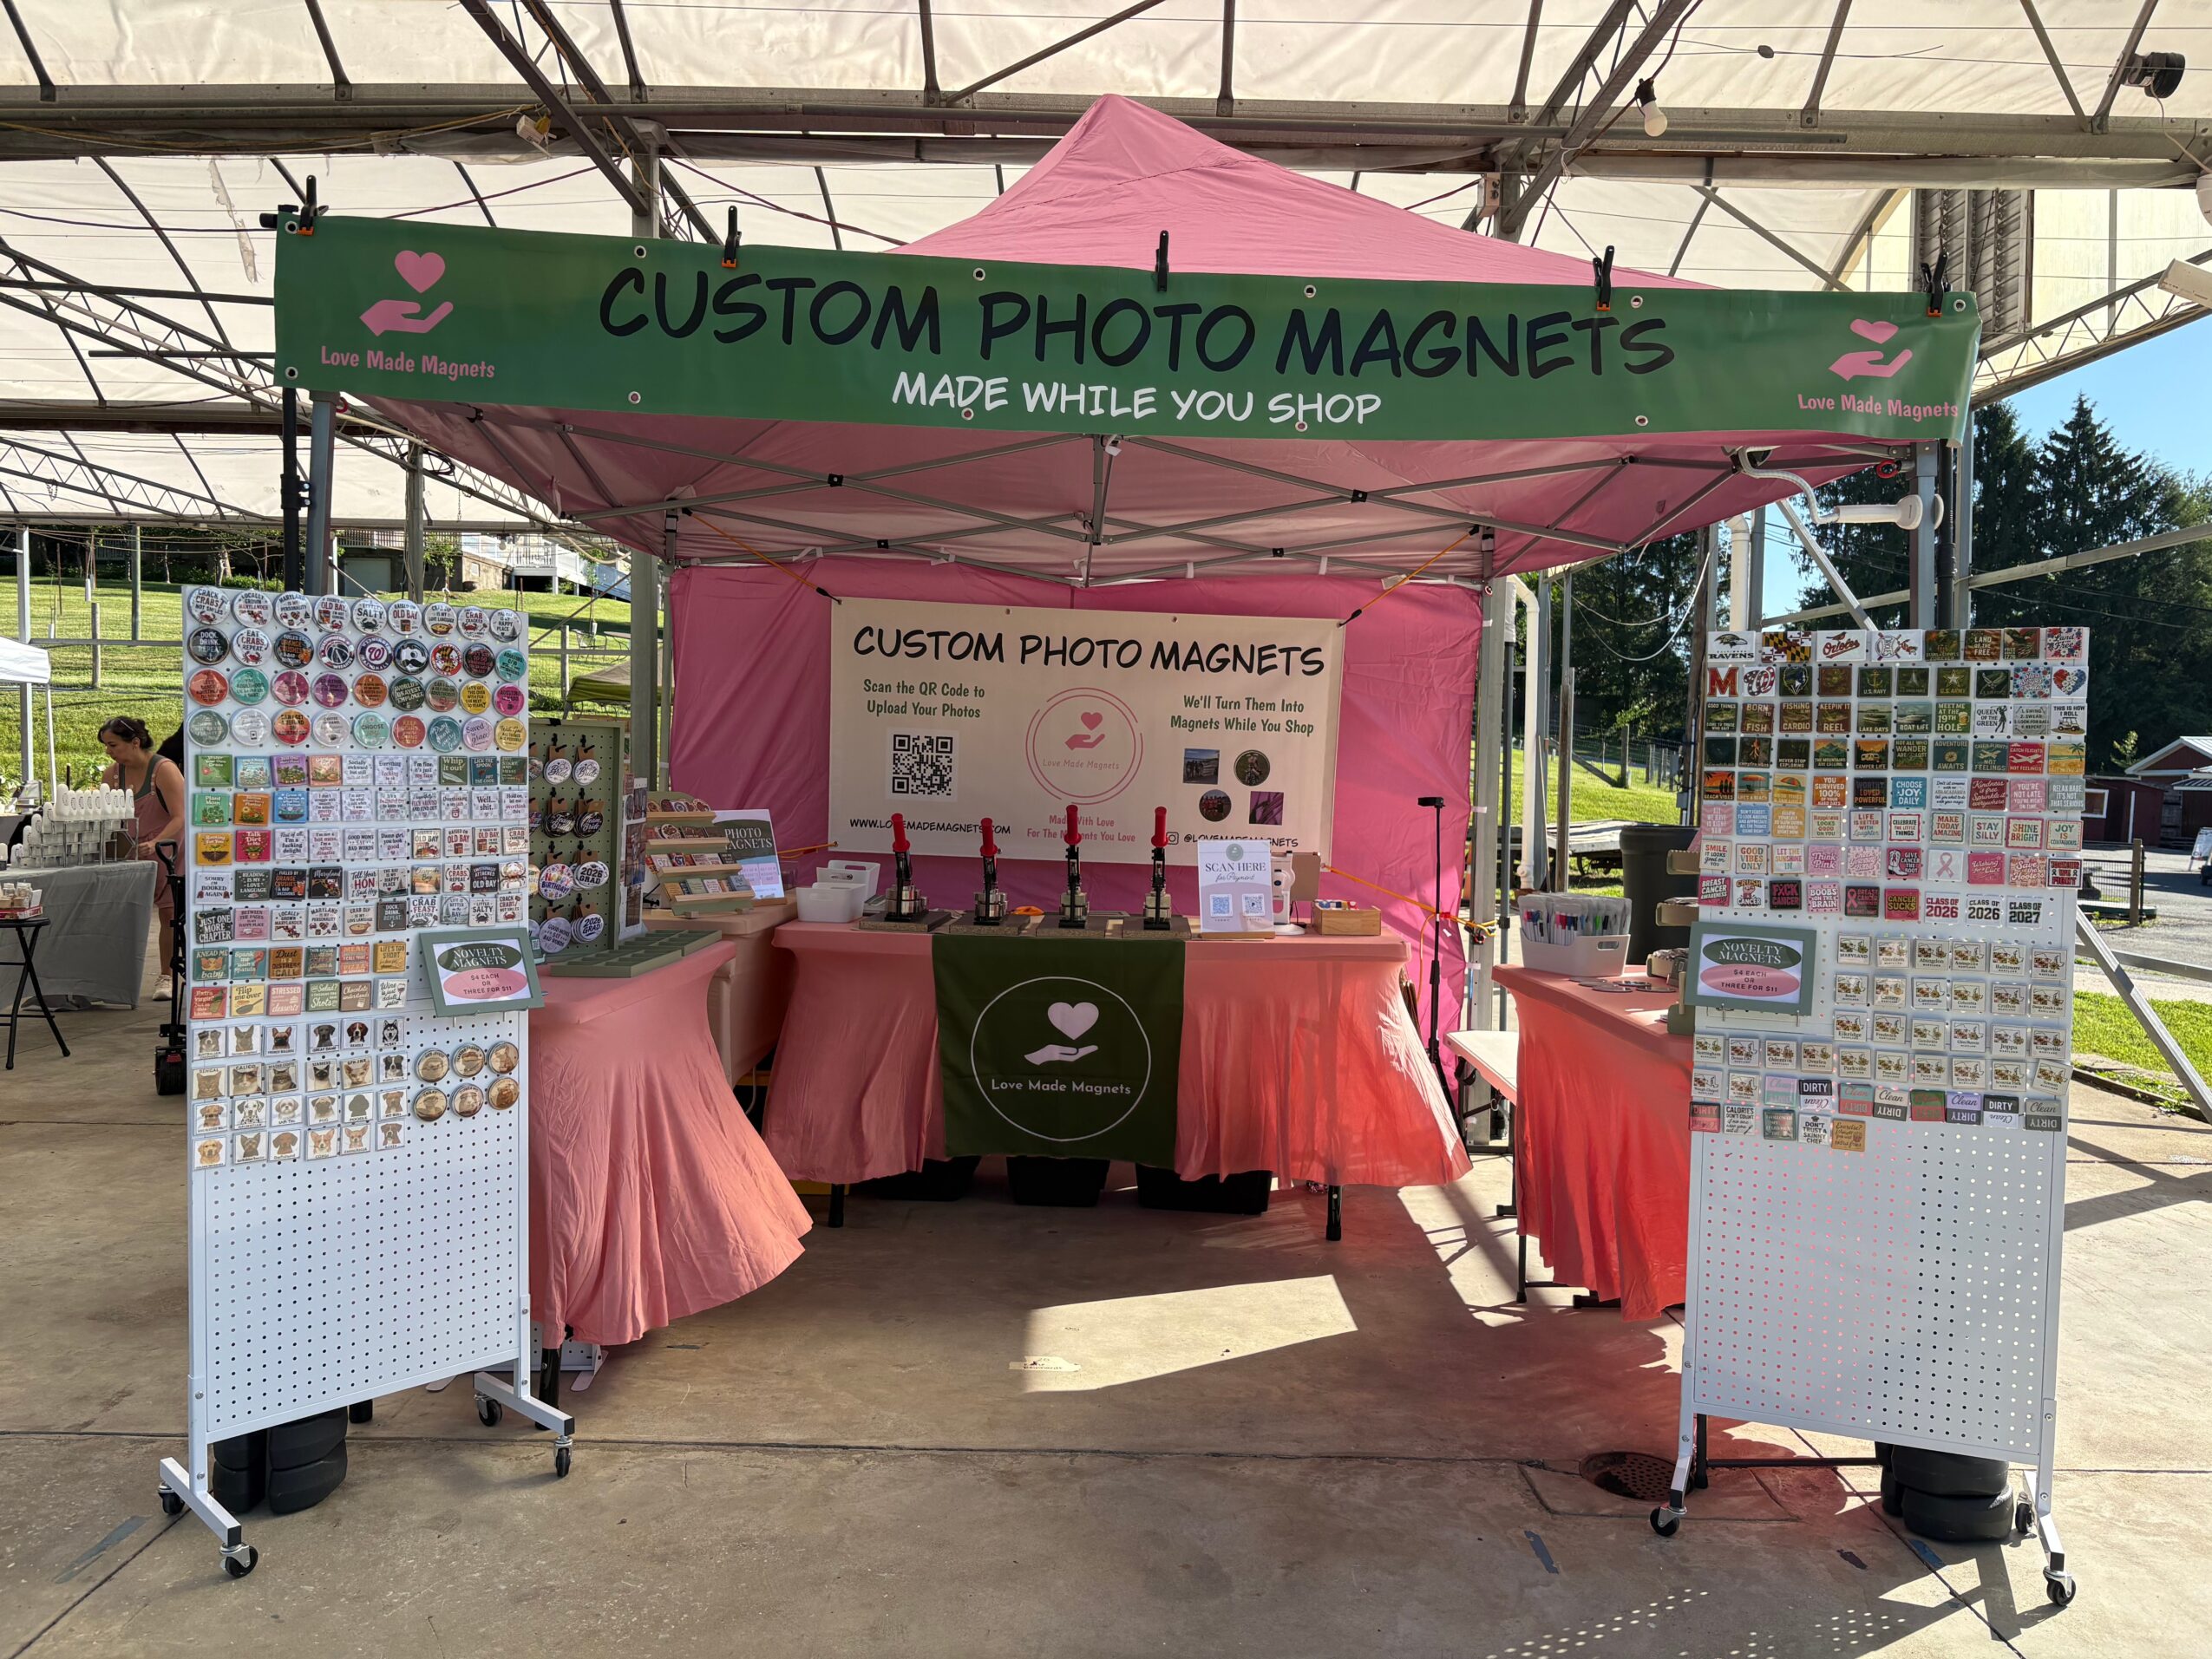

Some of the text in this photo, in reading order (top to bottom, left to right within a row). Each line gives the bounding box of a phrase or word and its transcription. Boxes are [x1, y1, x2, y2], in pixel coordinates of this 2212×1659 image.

[599, 266, 1675, 380] CUSTOM PHOTO MAGNETS
[320, 346, 495, 382] Love Made Magnets
[892, 371, 1382, 425] MADE WHILE YOU SHOP
[1798, 393, 1959, 422] Love Made Magnets
[393, 610, 417, 619] OLD BAY
[854, 625, 1325, 676] CUSTOM PHOTO MAGNETS
[1708, 667, 1738, 697] M
[863, 678, 985, 698] Scan the QR Code to
[867, 700, 980, 719] Upload Your Photos
[1183, 695, 1304, 713] We'll Turn Them Into
[1170, 715, 1314, 737] Magnets While You Shop
[1746, 723, 1767, 732] FISH
[443, 757, 463, 766] Whip
[1063, 760, 1083, 768] Made
[1087, 761, 1120, 770] Magnets
[1050, 815, 1067, 824] Mad
[1097, 818, 1115, 826] Love
[725, 828, 762, 839] PHOTO
[2012, 824, 2039, 833] SHINE
[1027, 828, 1040, 837] For
[1043, 829, 1057, 838] The
[1100, 832, 1114, 841] You
[1118, 833, 1135, 841] Love
[1976, 831, 1999, 839] SILLY
[2011, 833, 2039, 842] BRIGHT
[1206, 862, 1266, 872] SCAN HERE
[580, 868, 603, 878] 2026
[355, 878, 376, 889] HON
[473, 878, 496, 888] OLD BAY
[579, 875, 601, 884] GRAD
[541, 881, 569, 894] BIRTHDAY!
[1702, 885, 1727, 893] CANCER
[1888, 902, 1916, 911] SUCKS
[1926, 905, 1959, 918] 2026
[1968, 908, 1999, 920] 2026
[2009, 911, 2040, 924] 2027
[200, 916, 217, 927] JUST
[585, 918, 601, 927] 2026
[204, 924, 226, 933] MORE
[199, 931, 231, 944] CHAPTER
[454, 947, 505, 959] NOVELTY
[1723, 942, 1783, 955] NOVELTY
[454, 957, 507, 967] MAGNETS
[1719, 951, 1781, 963] MAGNETS
[991, 1079, 1131, 1094] Love Made Magnets
[1803, 1082, 1828, 1093] DIRTY
[1879, 1090, 1903, 1102] Clean
[1951, 1094, 1978, 1106] Clean
[1989, 1101, 2012, 1110] DIRTY
[2030, 1103, 2057, 1114] Clean
[1877, 1107, 1902, 1117] DIRTY
[1951, 1113, 1976, 1122] DIRTY
[2030, 1119, 2057, 1128] DIRTY
